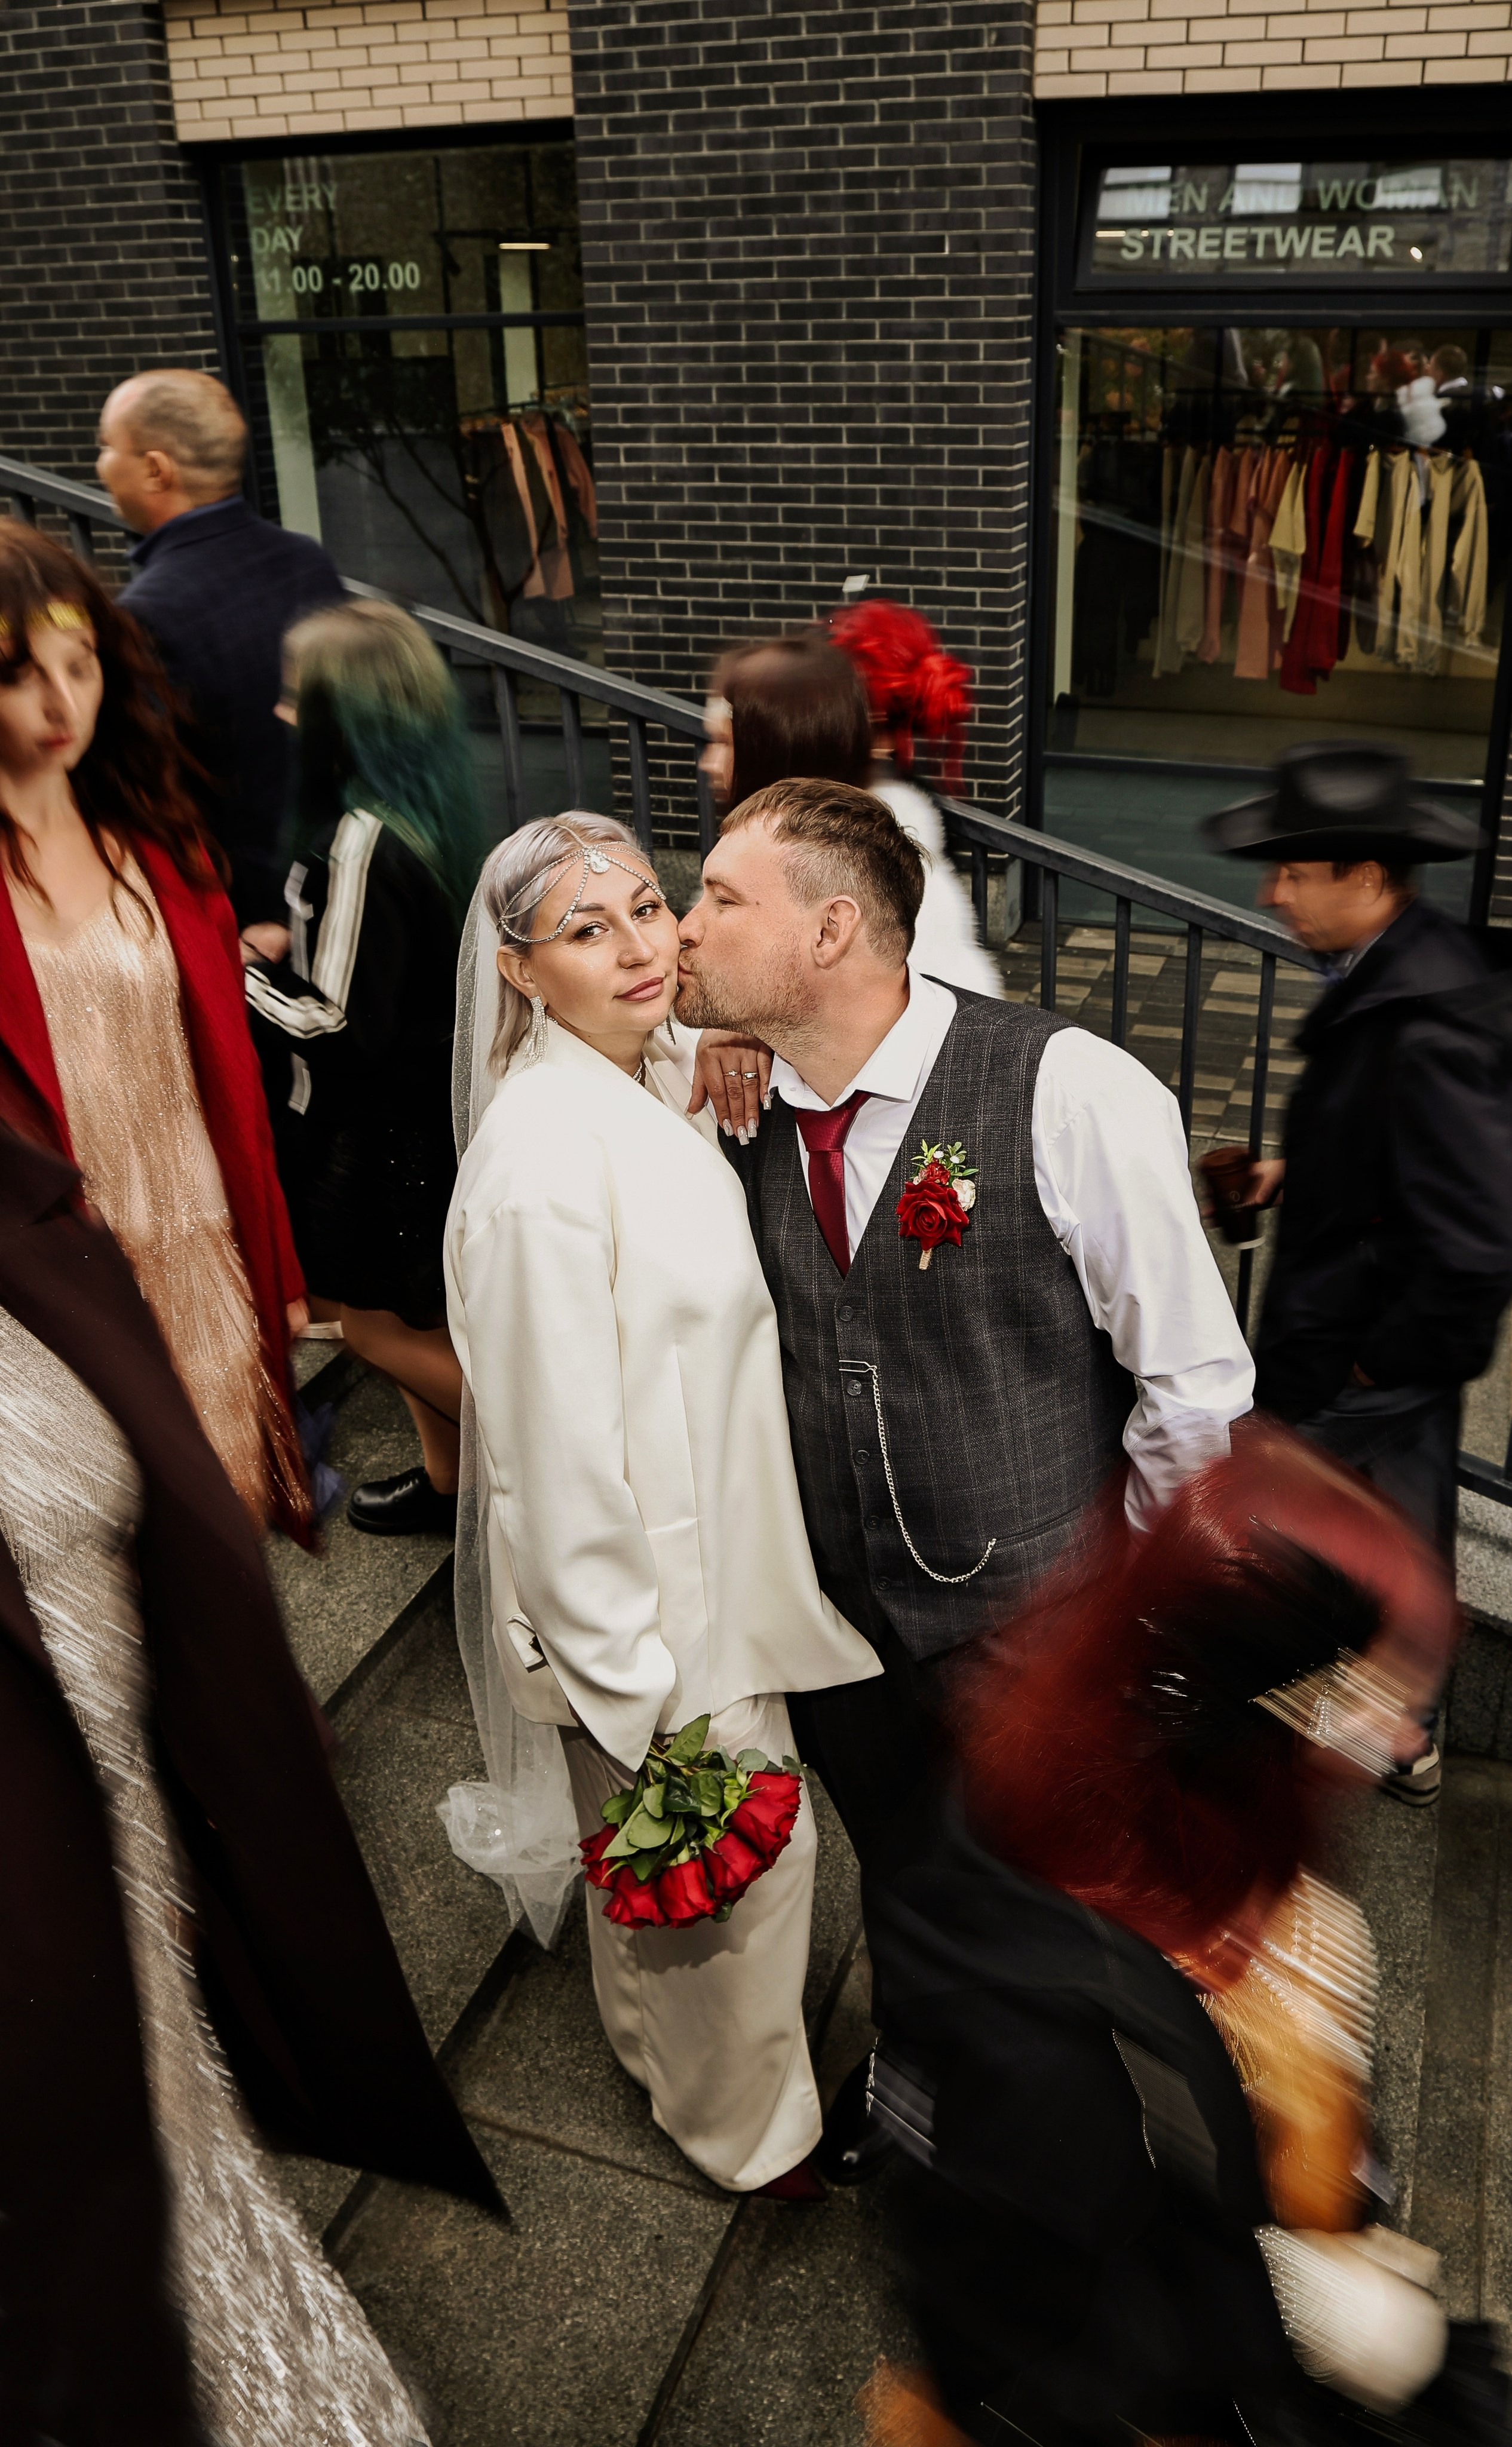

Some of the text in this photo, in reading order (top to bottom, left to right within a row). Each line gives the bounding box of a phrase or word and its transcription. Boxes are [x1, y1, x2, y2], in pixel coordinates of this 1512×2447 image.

[247, 182, 338, 213] EVERY
[251, 225, 303, 253] DAY
[1120, 225, 1396, 260] STREETWEAR
[348, 261, 421, 291] 20.00
